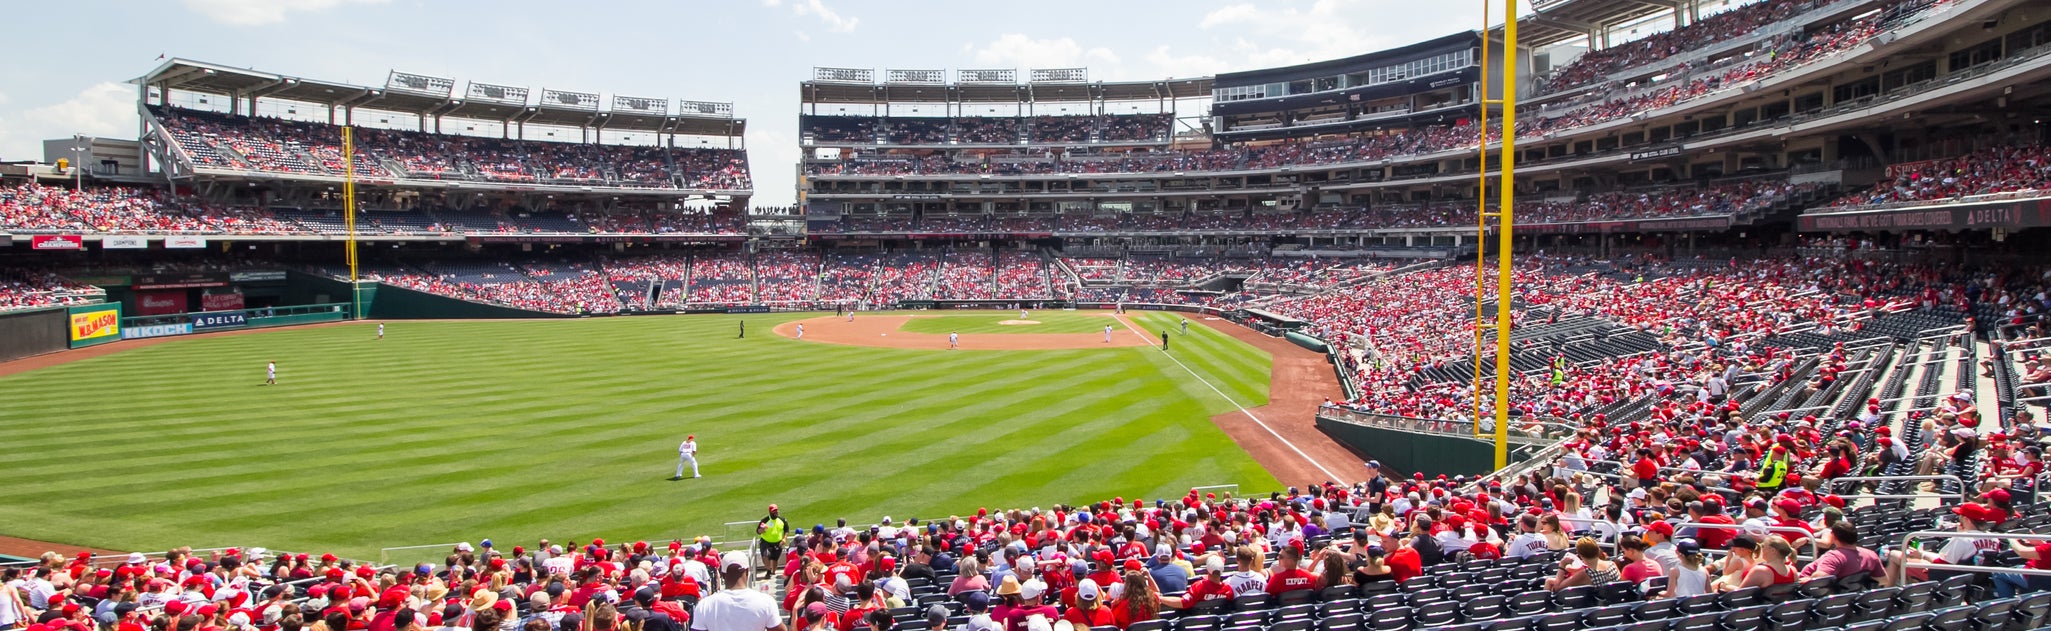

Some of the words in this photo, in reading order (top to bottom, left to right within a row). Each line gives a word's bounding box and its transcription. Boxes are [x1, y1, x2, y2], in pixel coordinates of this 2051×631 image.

[1976, 208, 2010, 223] DELTA
[207, 315, 245, 325] DELTA
[142, 323, 187, 336] KOCH
[1236, 580, 1263, 596] HARPER
